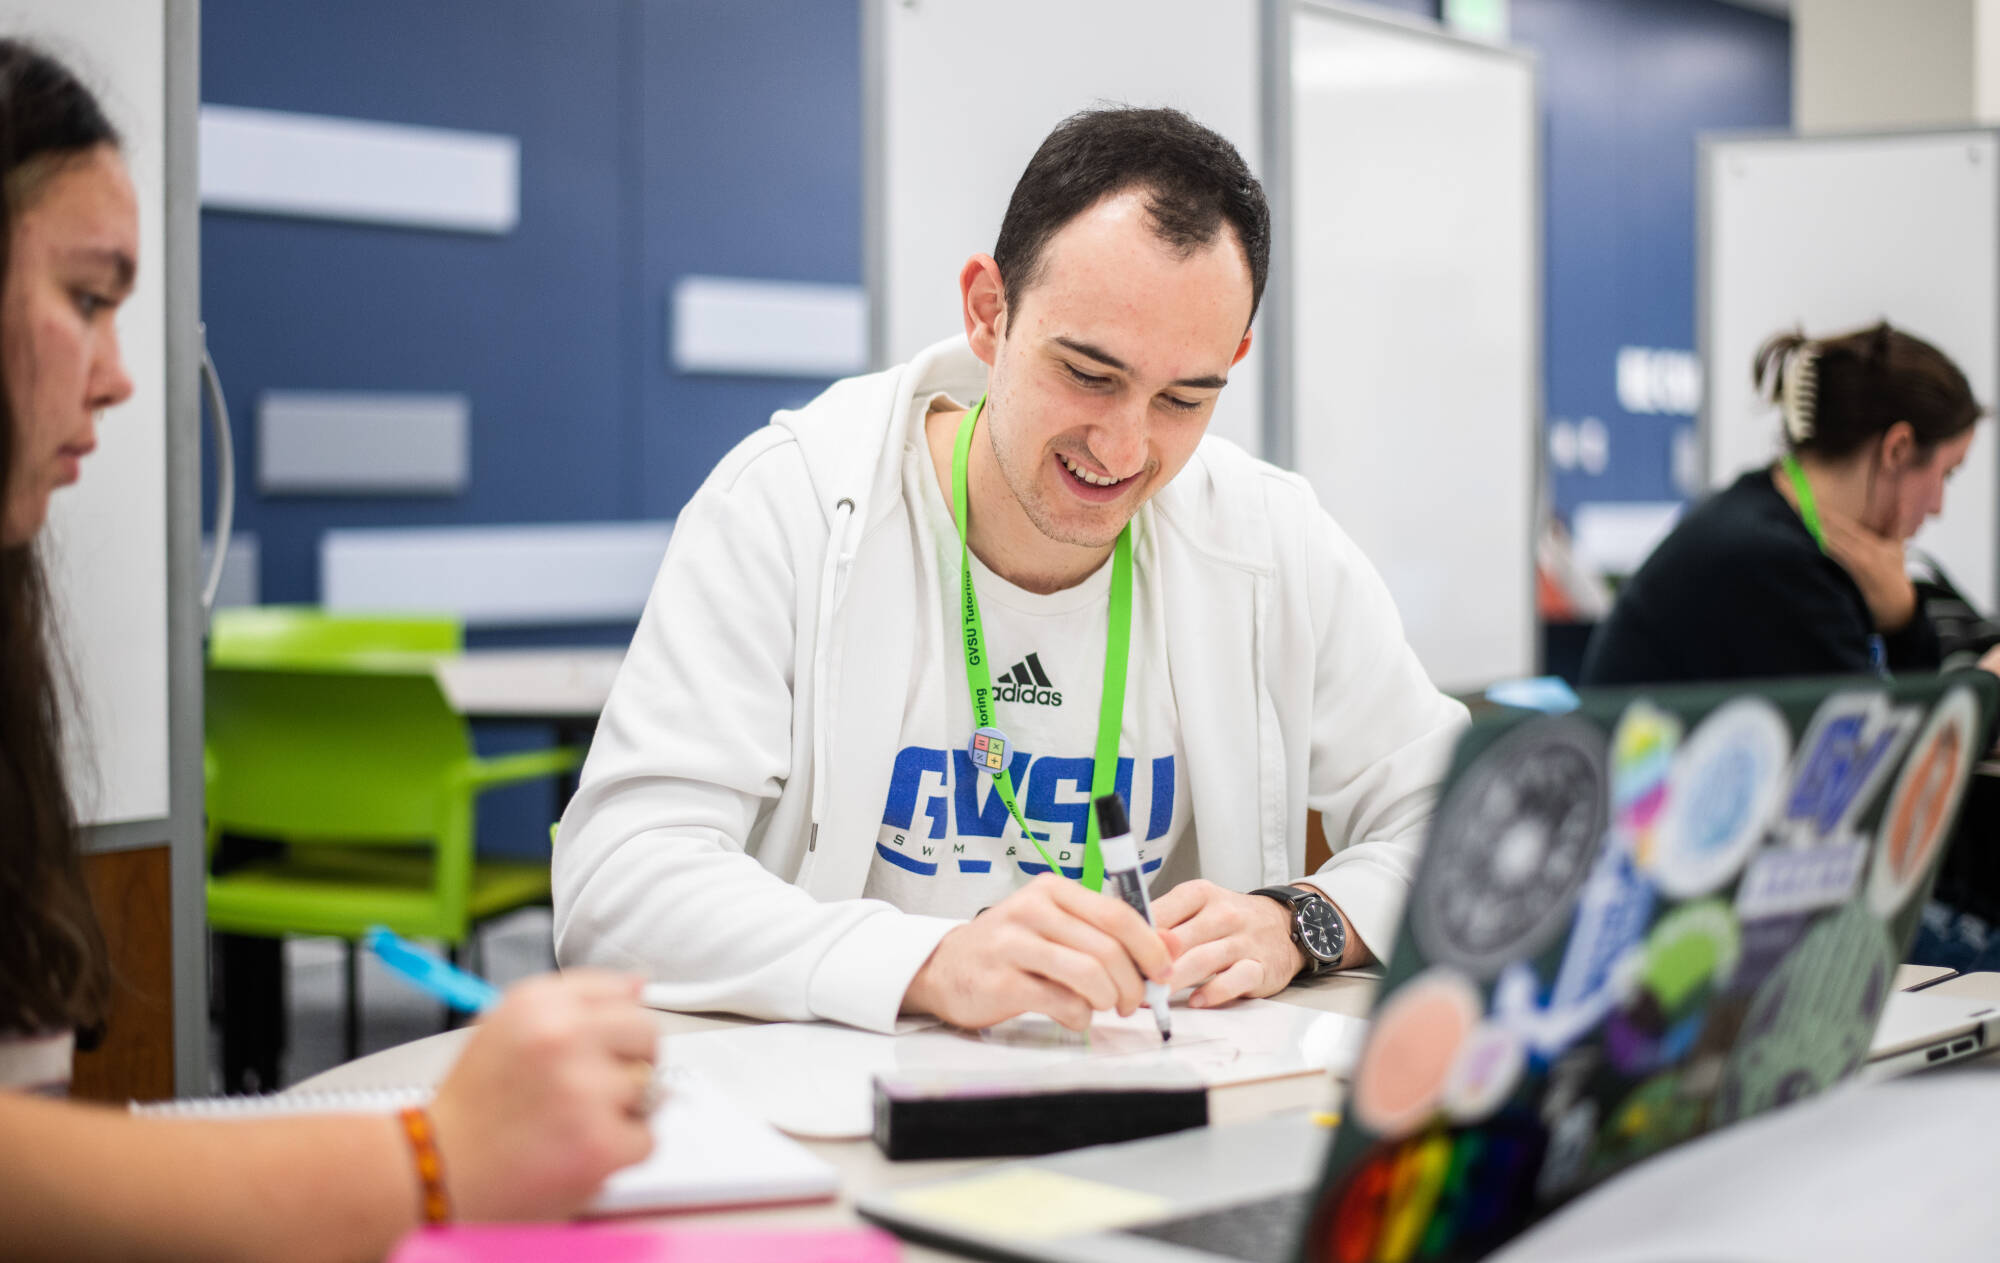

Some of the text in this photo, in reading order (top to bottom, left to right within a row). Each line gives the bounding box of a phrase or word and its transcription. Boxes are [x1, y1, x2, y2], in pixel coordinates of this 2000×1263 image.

[965, 628, 980, 666] GVSU
[976, 688, 989, 727] toring
[992, 683, 1063, 707] adidas
[876, 746, 1175, 879] GVSU
